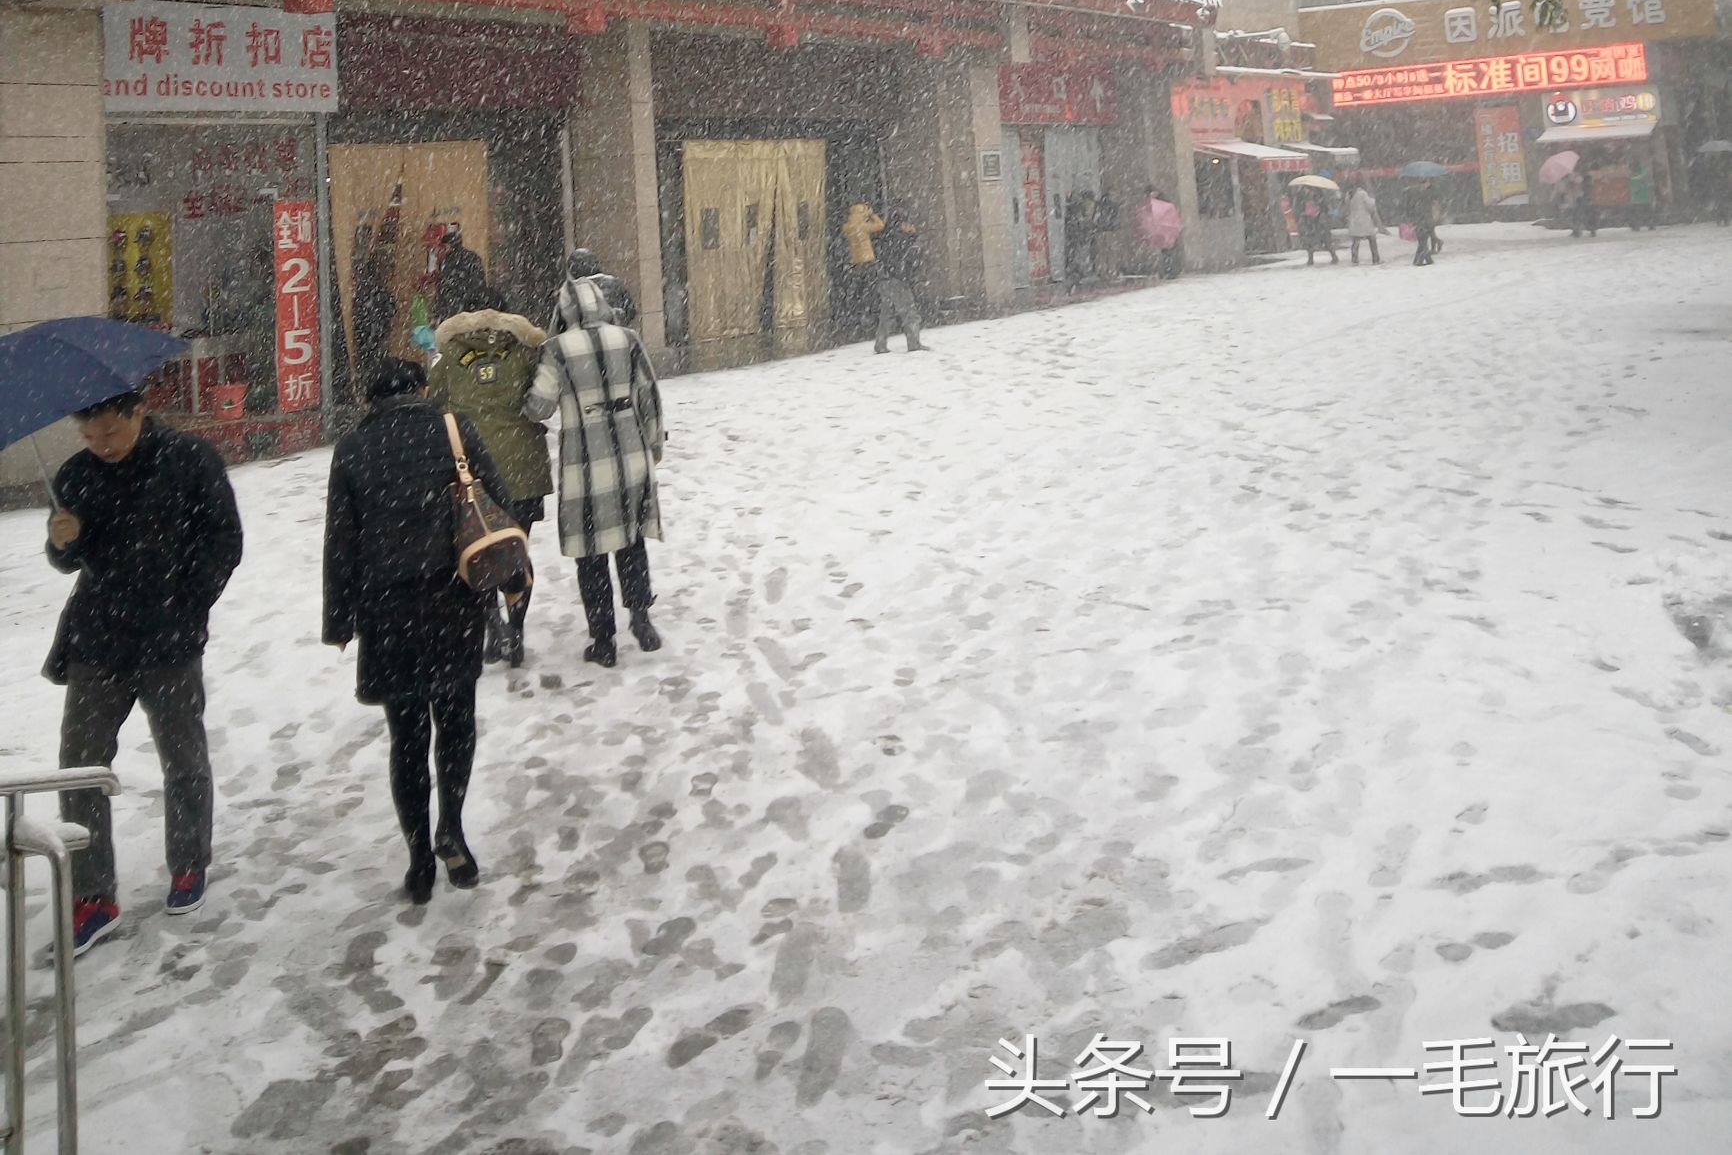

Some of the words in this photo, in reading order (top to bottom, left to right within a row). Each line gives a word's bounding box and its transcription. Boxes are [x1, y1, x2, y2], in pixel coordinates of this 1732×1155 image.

[128, 15, 334, 70] 牌折扣店
[155, 73, 267, 99] discount
[271, 78, 332, 98] store
[1497, 131, 1523, 184] 招租
[480, 366, 494, 380] 59
